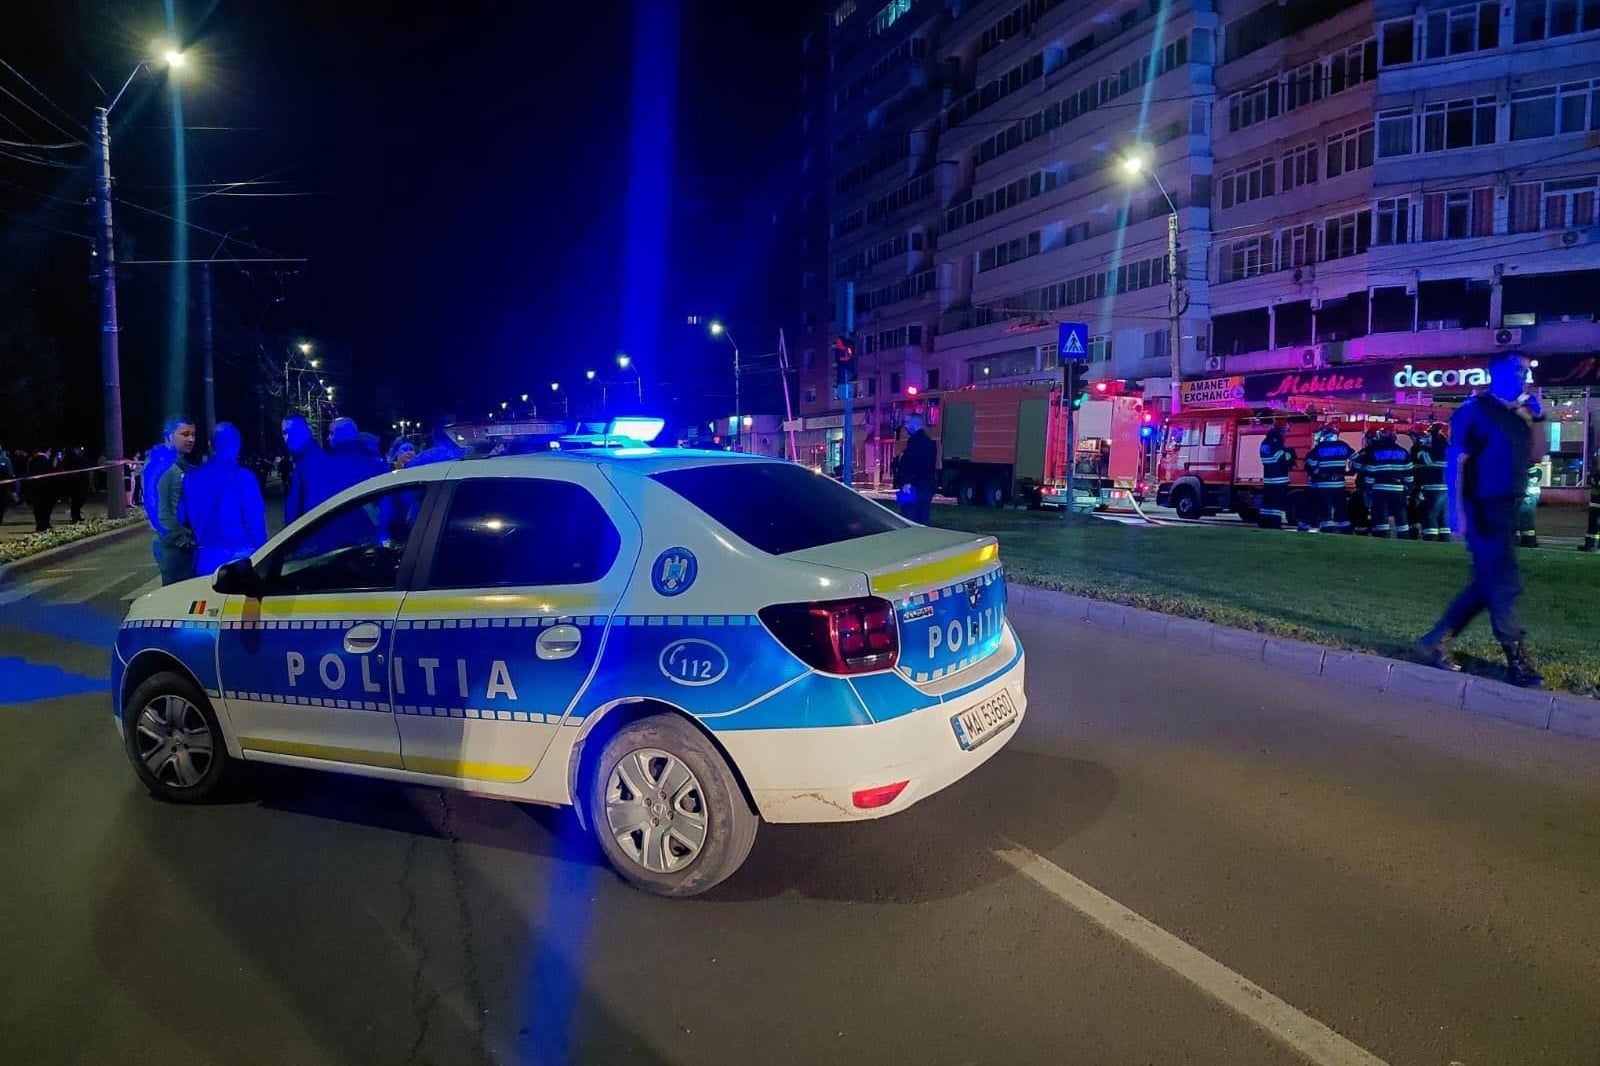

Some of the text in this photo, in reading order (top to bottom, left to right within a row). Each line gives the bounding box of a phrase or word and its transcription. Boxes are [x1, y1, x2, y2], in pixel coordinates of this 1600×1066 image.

[1184, 390, 1233, 402] EXCHANG
[1190, 379, 1231, 392] AMANET
[1266, 374, 1365, 397] Mobilier
[286, 651, 518, 700] POLITIA
[681, 658, 712, 678] 112
[963, 694, 1012, 740] MAI 53660
